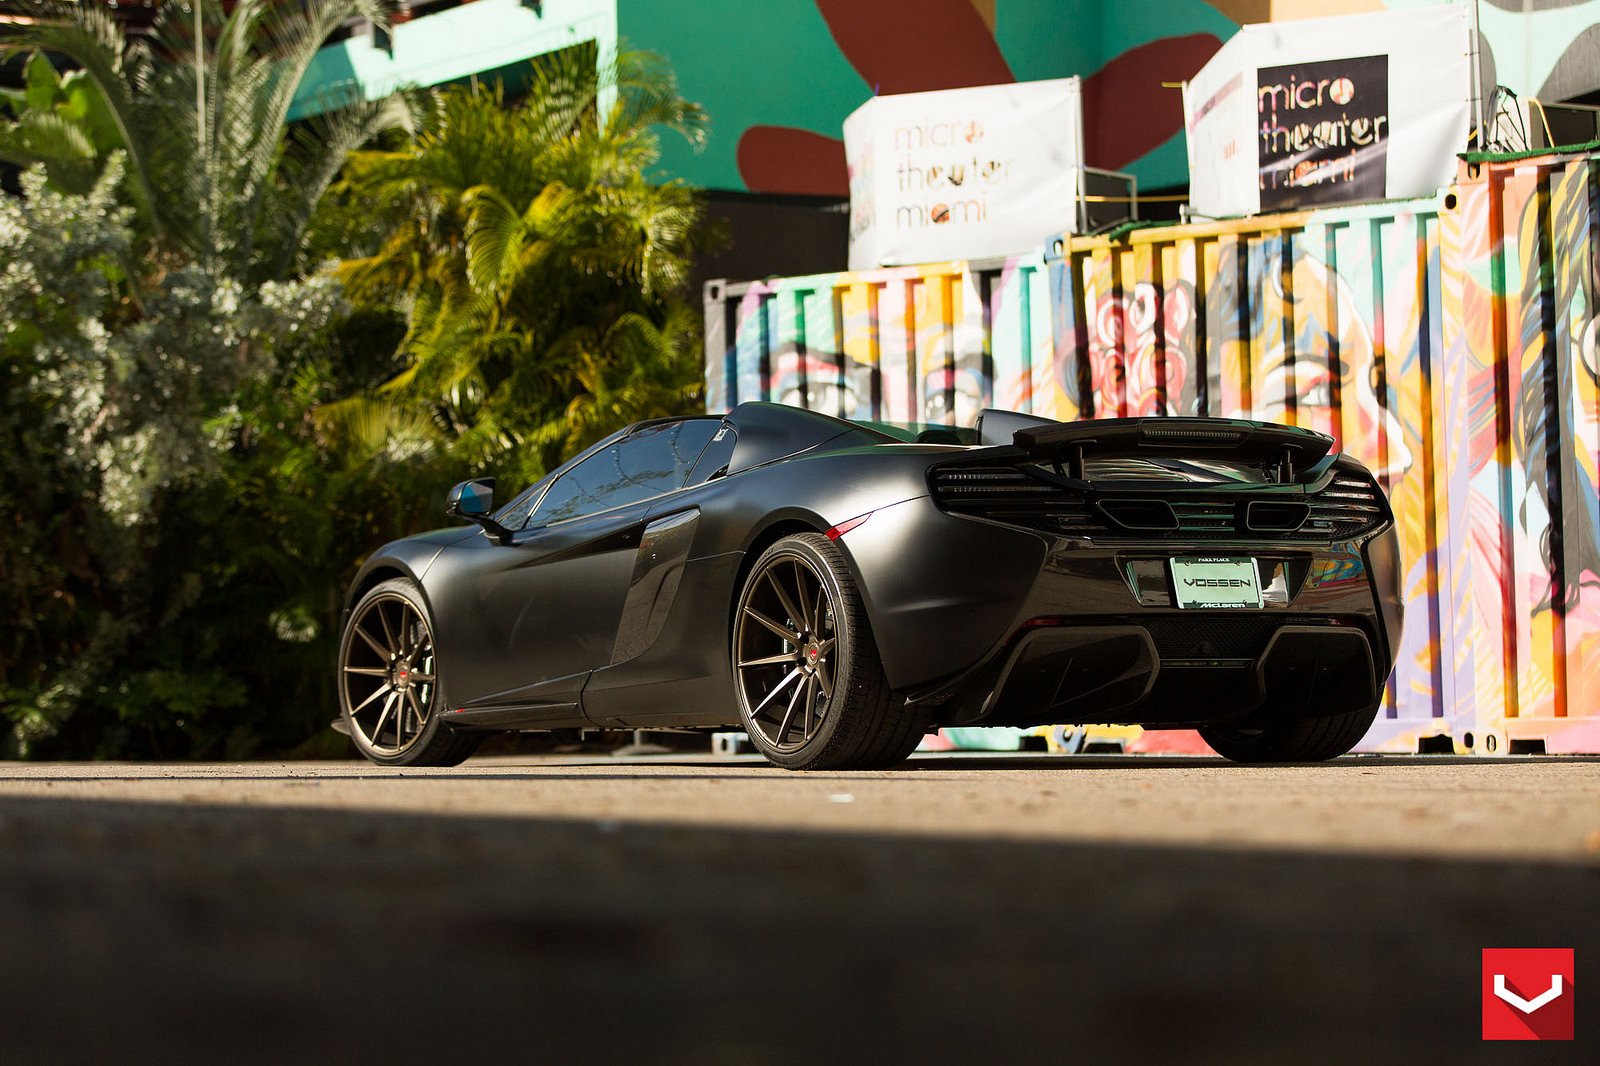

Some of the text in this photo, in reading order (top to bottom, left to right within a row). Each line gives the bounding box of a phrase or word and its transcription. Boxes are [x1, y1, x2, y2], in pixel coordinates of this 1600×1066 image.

[1257, 74, 1355, 113] micro
[895, 116, 985, 151] micro
[1259, 112, 1387, 154] theater
[896, 190, 987, 229] miami
[1183, 578, 1251, 588] VOSSEN
